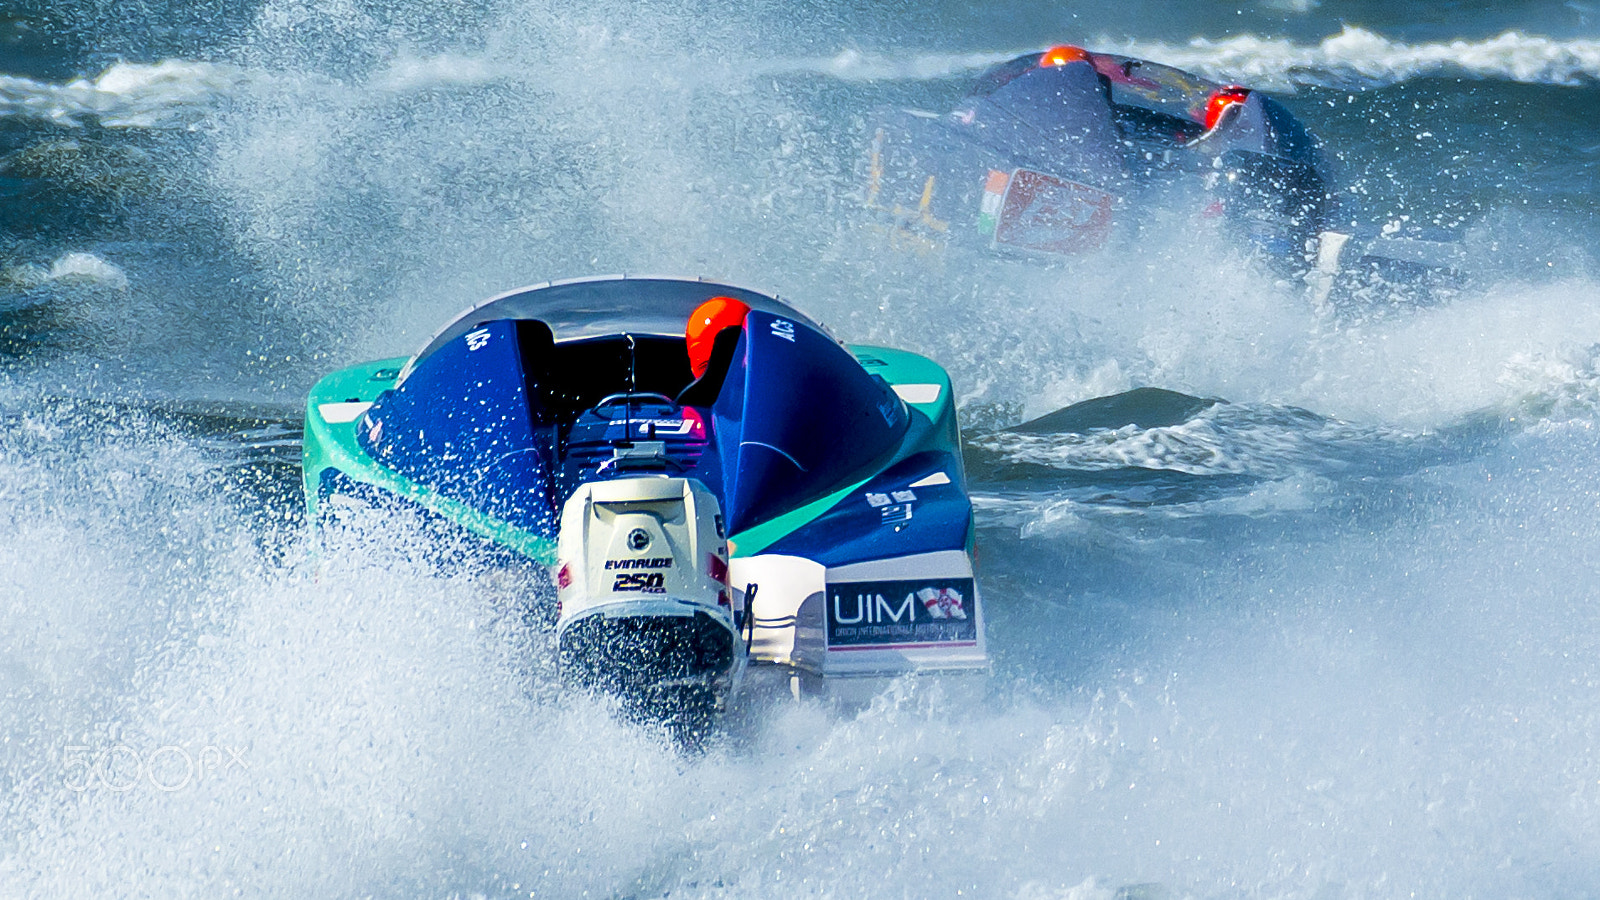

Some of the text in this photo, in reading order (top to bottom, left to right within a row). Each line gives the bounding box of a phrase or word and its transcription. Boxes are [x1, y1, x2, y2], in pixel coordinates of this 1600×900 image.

[604, 557, 674, 570] EVINRUDE
[612, 572, 665, 592] 250
[834, 592, 916, 625] UIM
